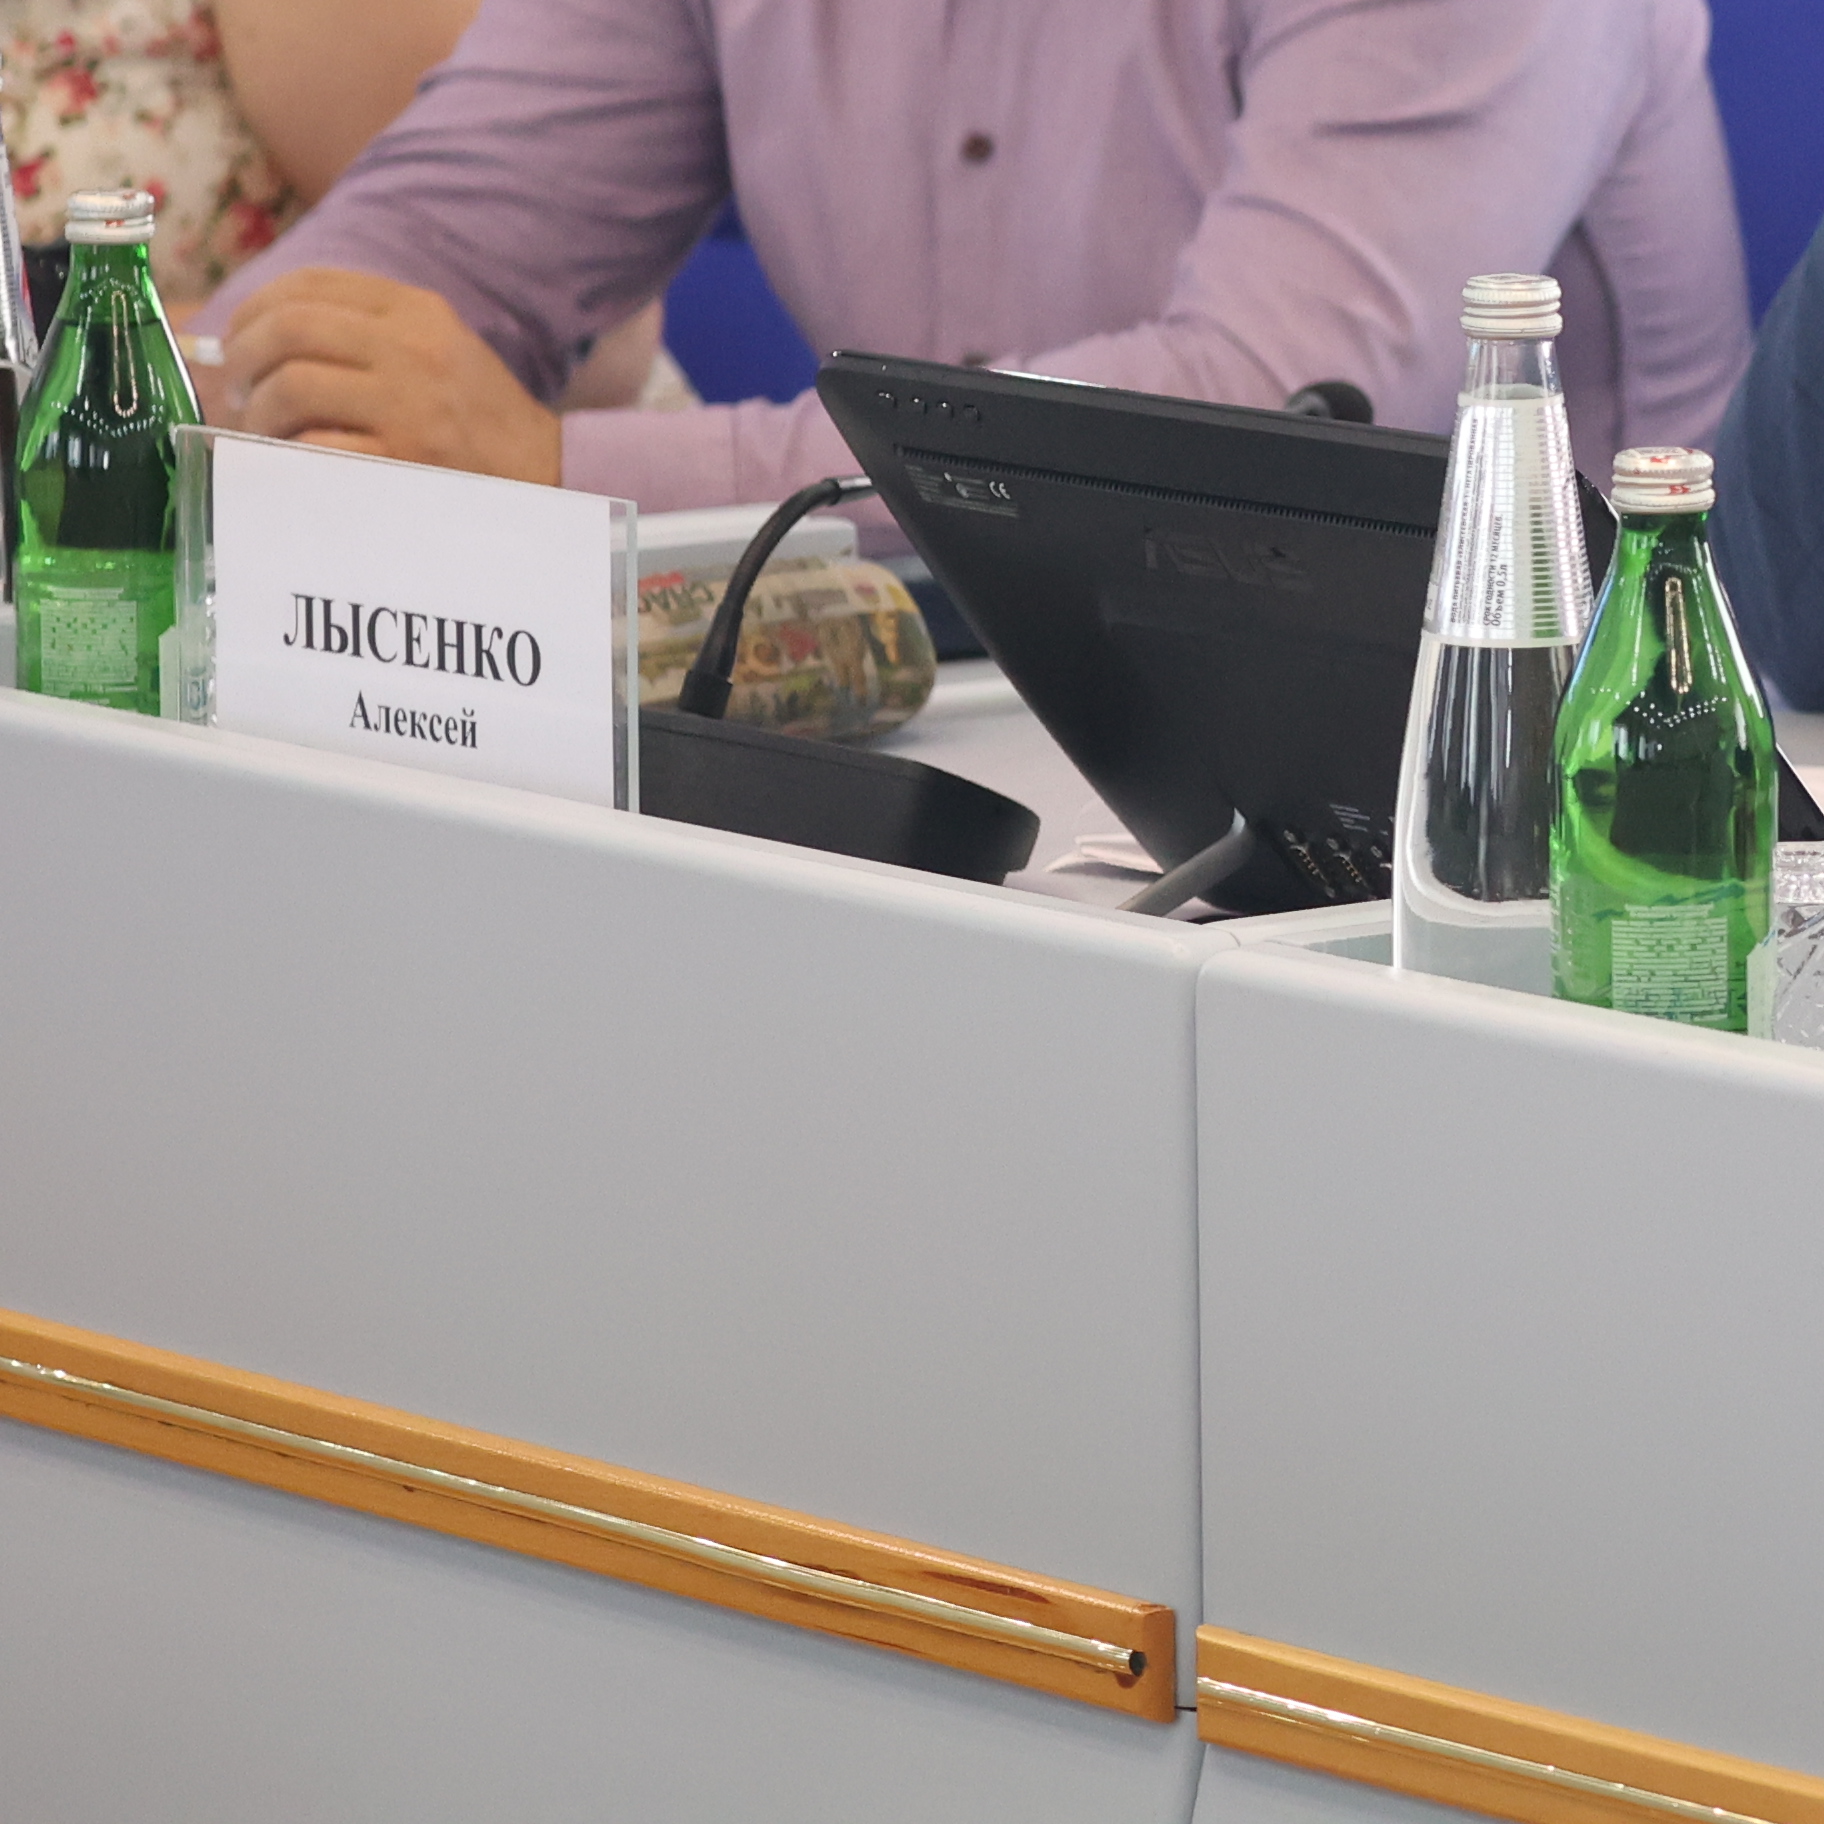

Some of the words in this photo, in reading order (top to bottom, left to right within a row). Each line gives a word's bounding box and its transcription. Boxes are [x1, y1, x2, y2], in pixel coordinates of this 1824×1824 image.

[1485, 565, 1497, 605] ГОДНОСТИ
[1491, 589, 1506, 628] Объем
[282, 593, 542, 687] ЛЫСЕНКО
[349, 691, 478, 748] Алексей
